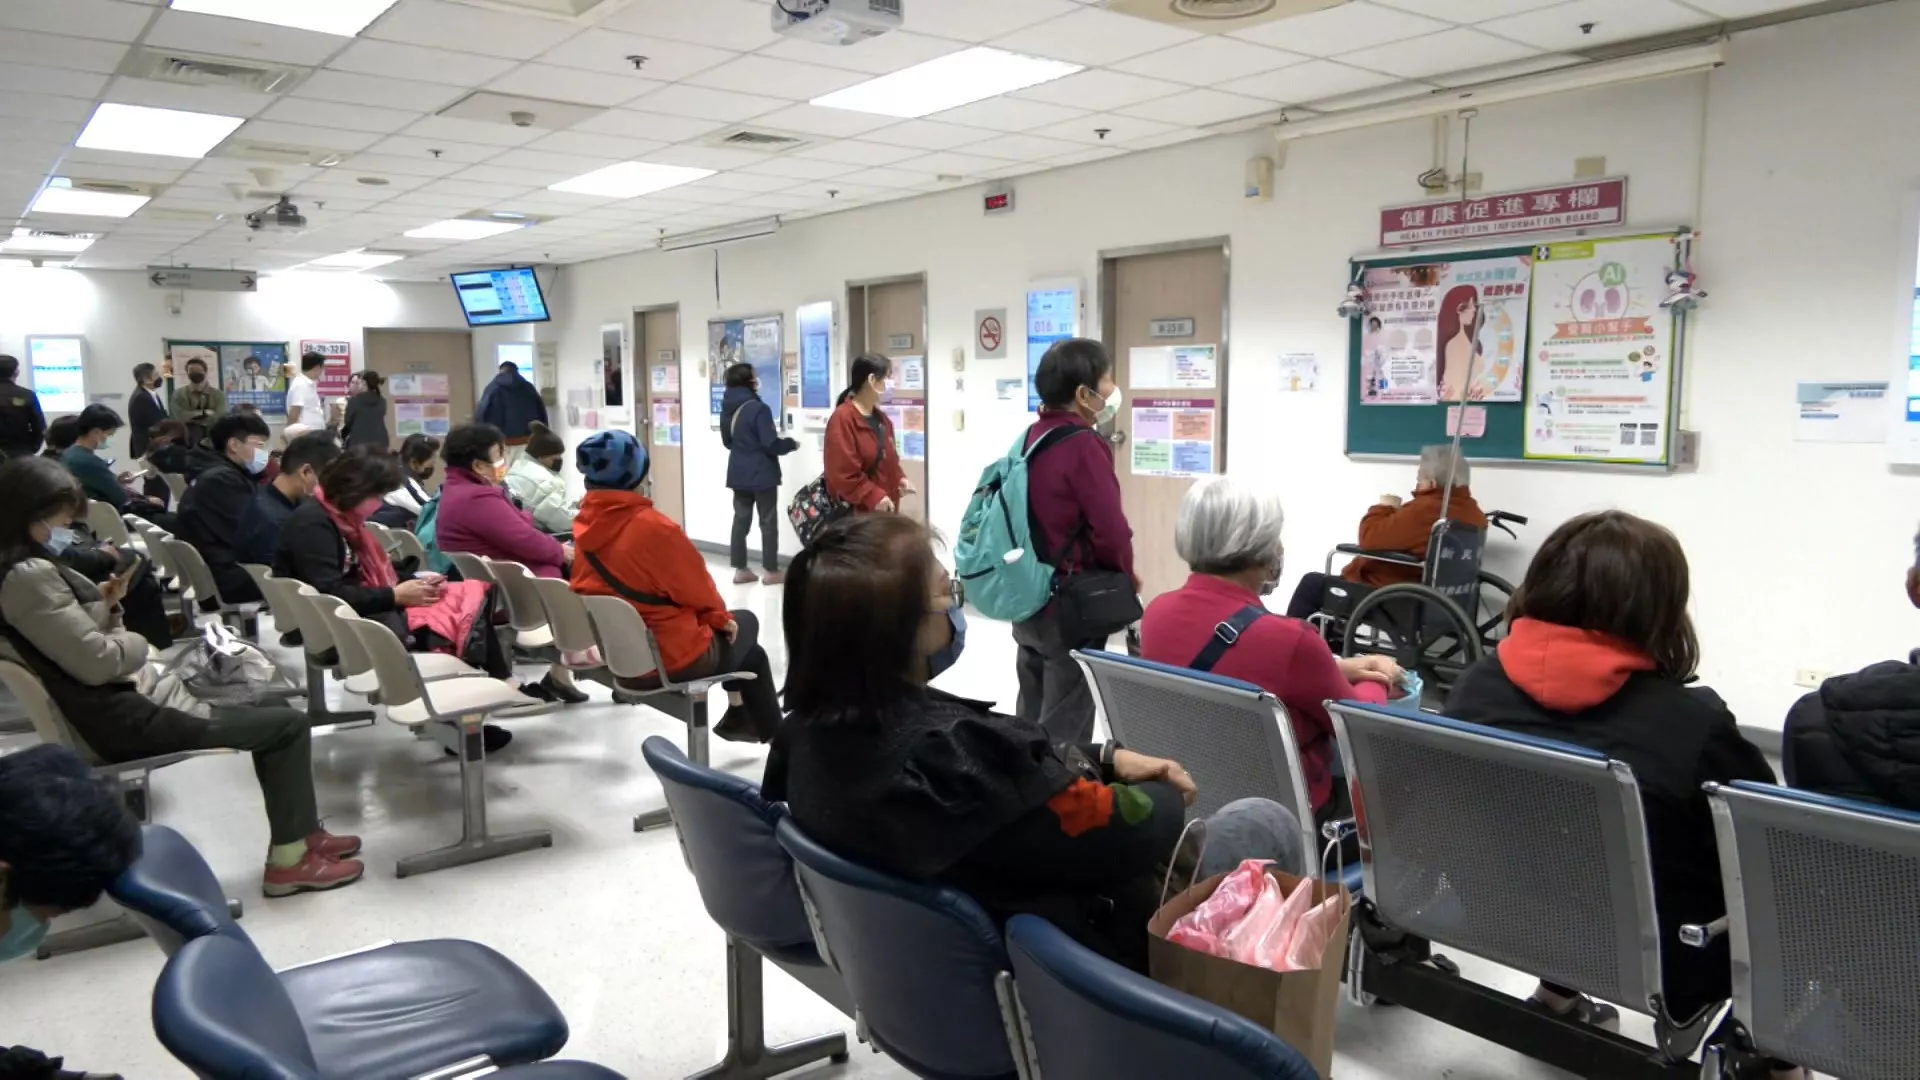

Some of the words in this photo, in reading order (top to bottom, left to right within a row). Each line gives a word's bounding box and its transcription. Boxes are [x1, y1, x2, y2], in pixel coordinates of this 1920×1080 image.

[1400, 186, 1600, 228] 健康促進專欄
[1400, 231, 1434, 241] HEALTH
[1436, 223, 1489, 237] PROMOTION
[1493, 216, 1562, 233] INFORMATION
[1565, 211, 1600, 223] BOARD
[1603, 265, 1622, 279] AI
[1034, 320, 1053, 333] 016
